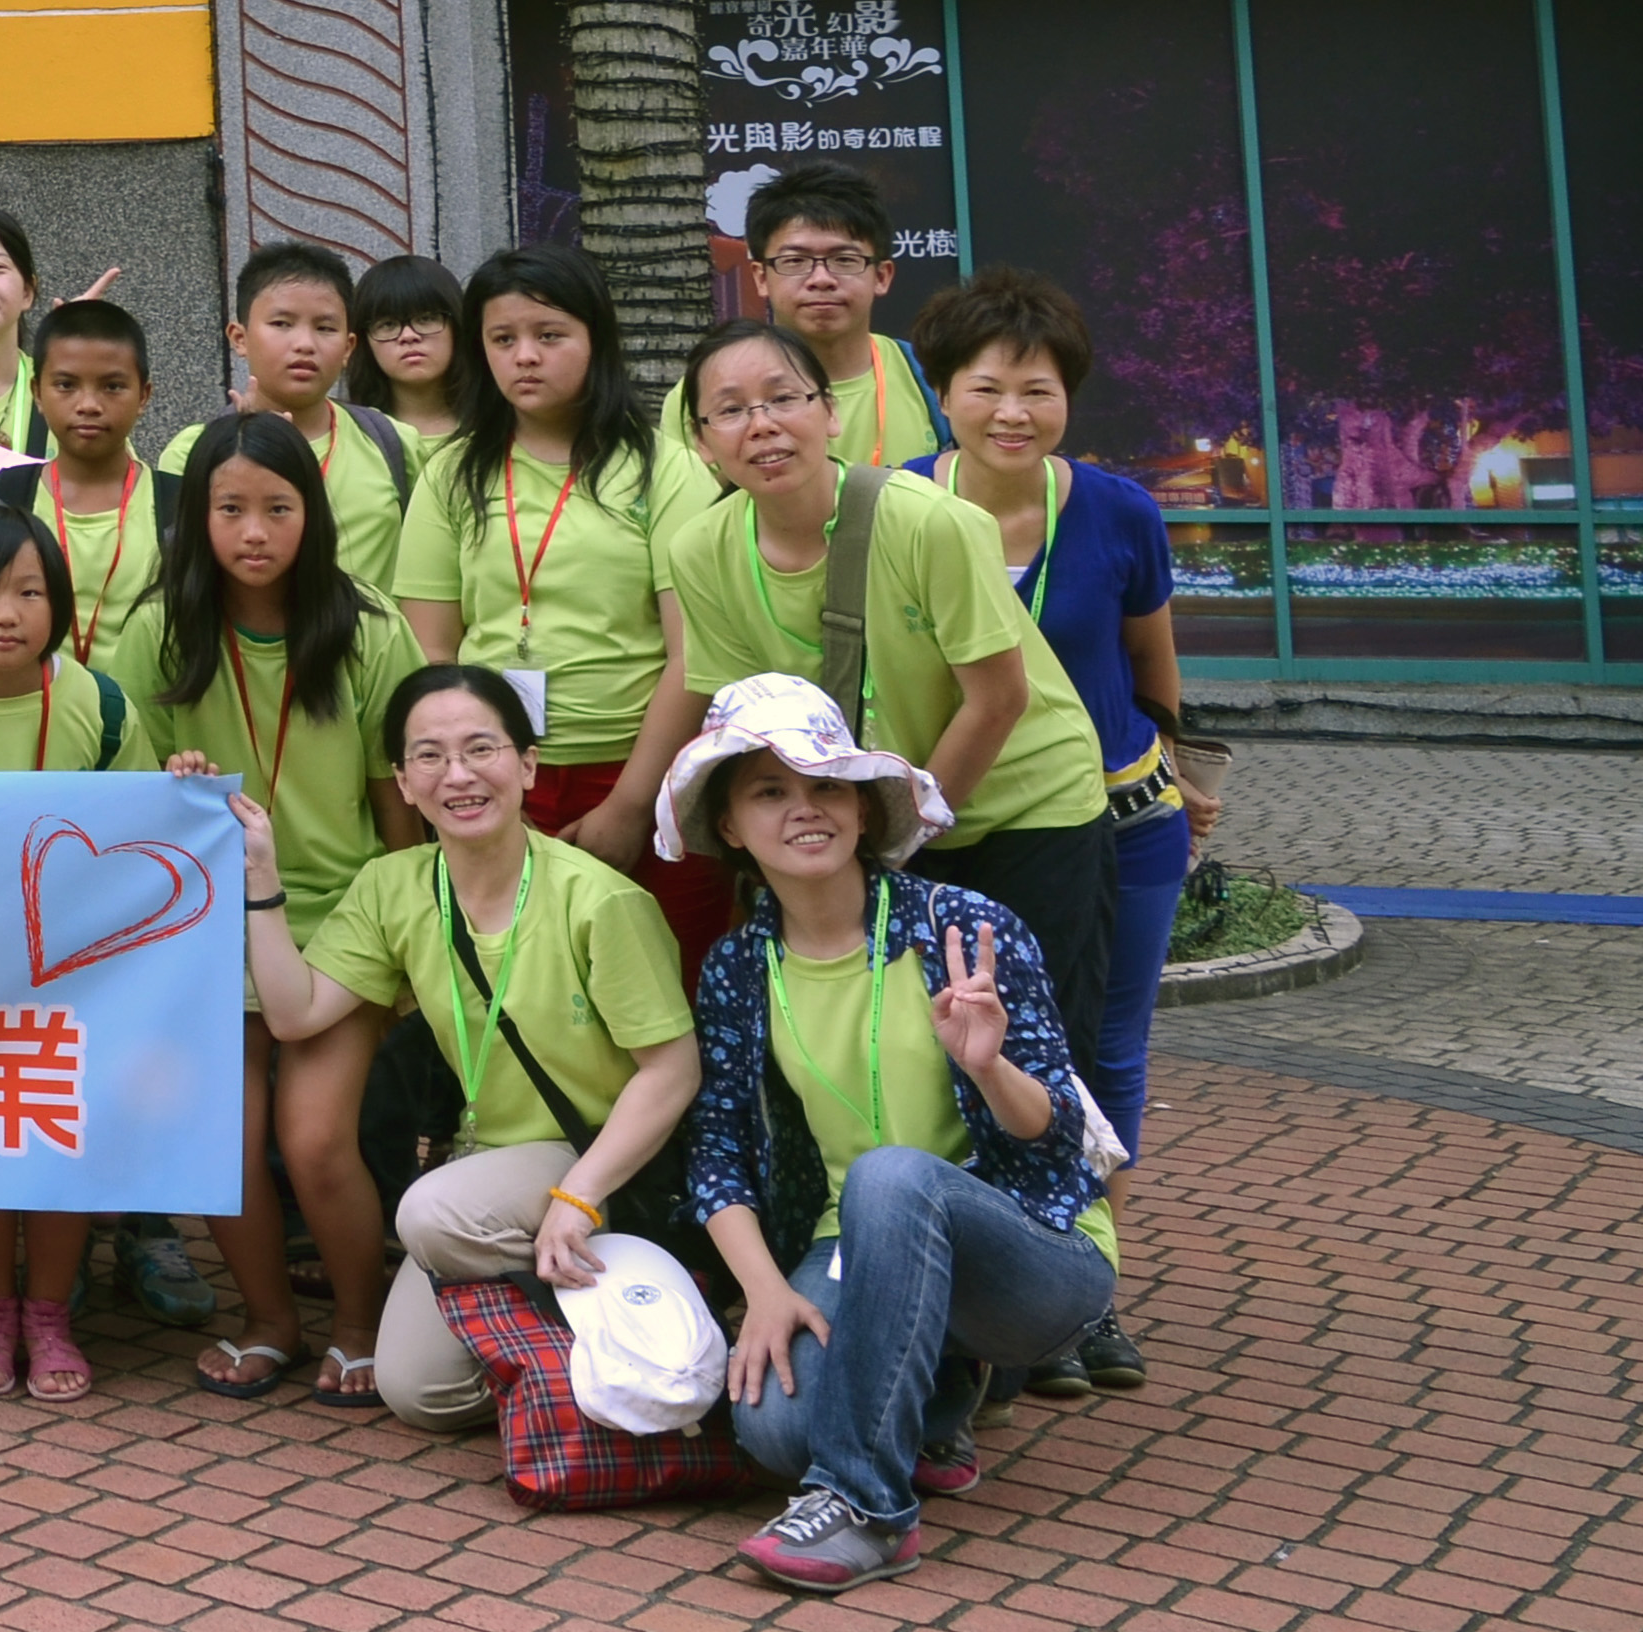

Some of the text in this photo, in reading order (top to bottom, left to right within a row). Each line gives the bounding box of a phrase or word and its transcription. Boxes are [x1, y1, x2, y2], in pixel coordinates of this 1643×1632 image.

[781, 35, 867, 62] 嘉年華
[707, 120, 942, 154] 光與影的奇幻旅程
